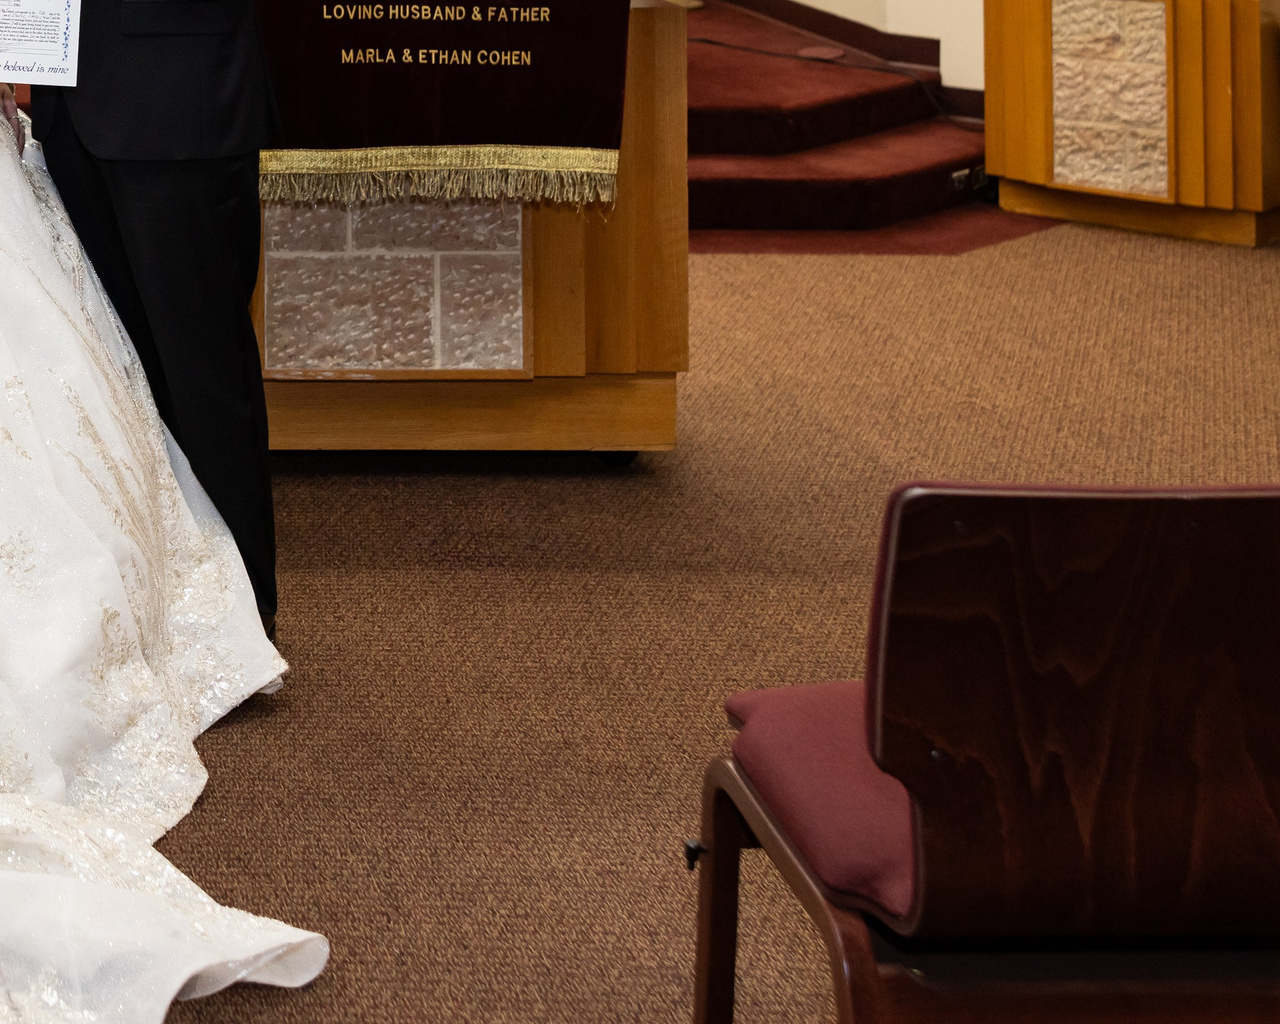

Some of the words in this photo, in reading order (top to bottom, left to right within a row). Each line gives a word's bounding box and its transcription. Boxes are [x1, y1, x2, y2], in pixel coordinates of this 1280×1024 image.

[323, 5, 384, 20] LOVING
[389, 5, 466, 21] HUSBAND
[471, 7, 483, 21] &
[488, 7, 550, 22] FATHER
[341, 49, 396, 64] MARLA
[402, 49, 413, 63] &
[418, 50, 472, 65] ETHAN
[477, 50, 531, 66] COHEN
[3, 60, 36, 72] beloved
[36, 64, 45, 73] is
[47, 64, 69, 74] mine
